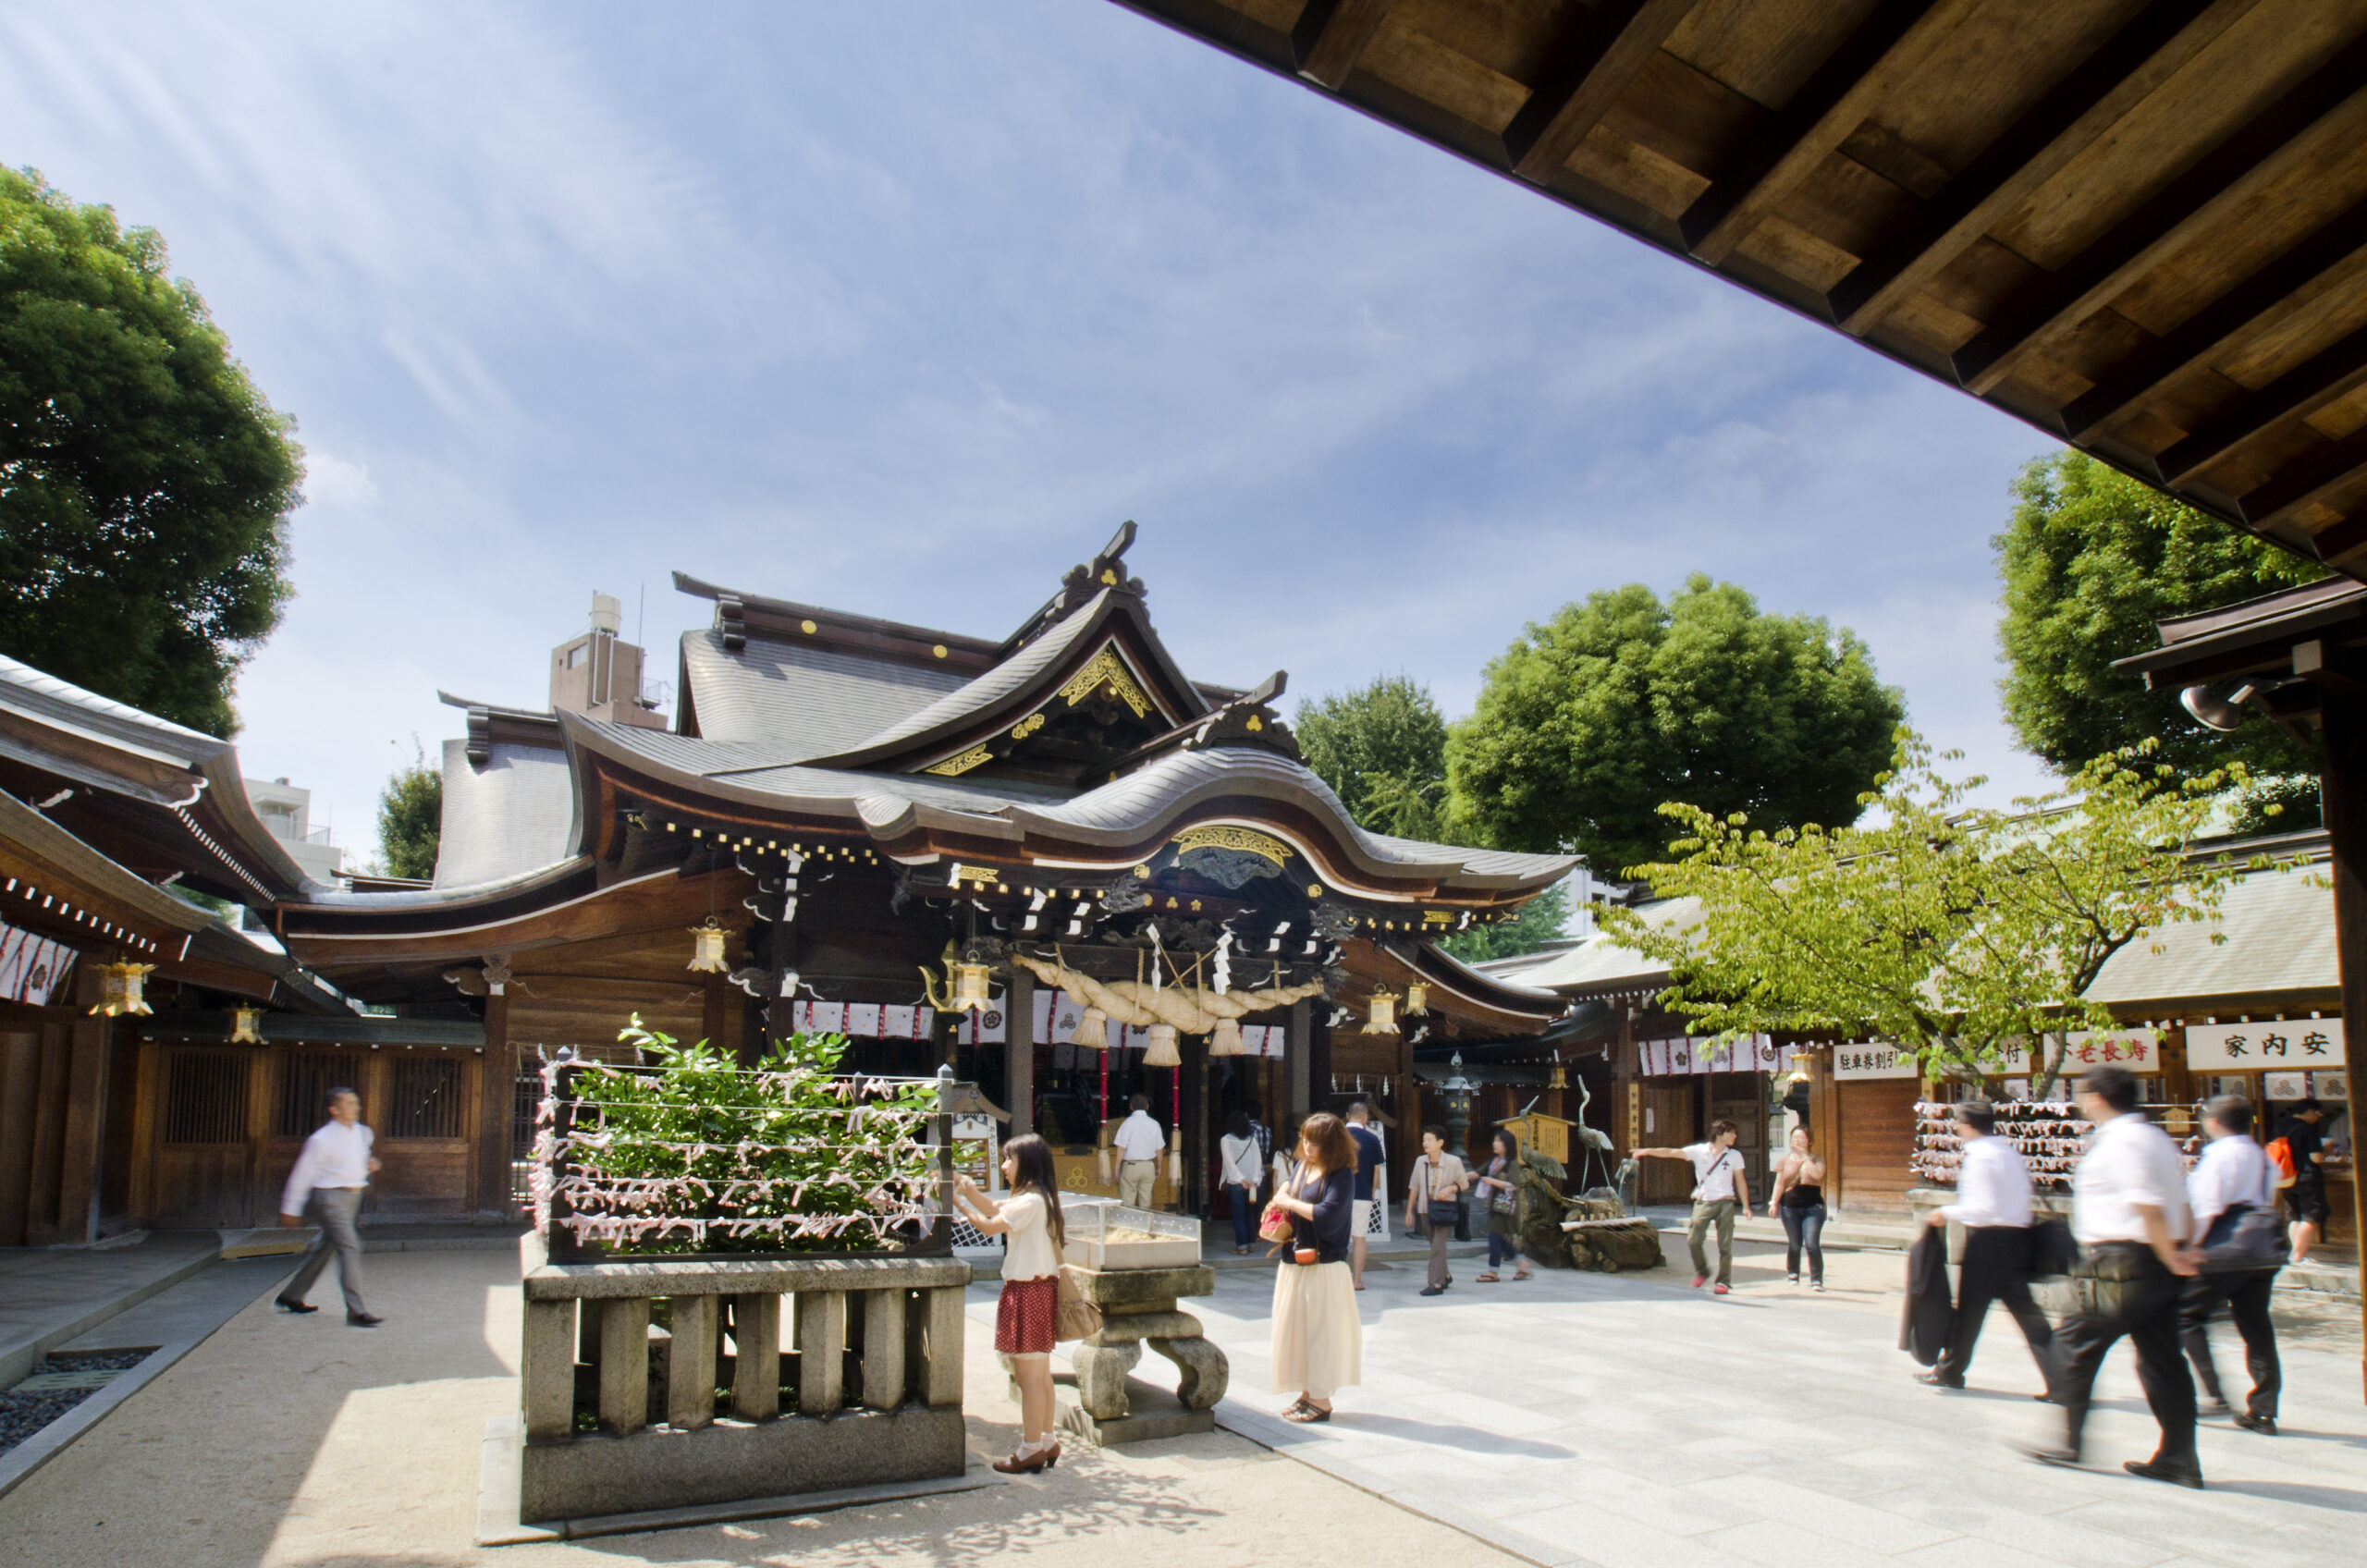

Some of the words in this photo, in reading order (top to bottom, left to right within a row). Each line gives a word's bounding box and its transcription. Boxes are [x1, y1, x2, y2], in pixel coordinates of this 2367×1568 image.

[2065, 1038, 2149, 1063] 老長寿
[2225, 1031, 2330, 1058] 家内安
[1840, 1049, 1909, 1071] 駐車券割引
